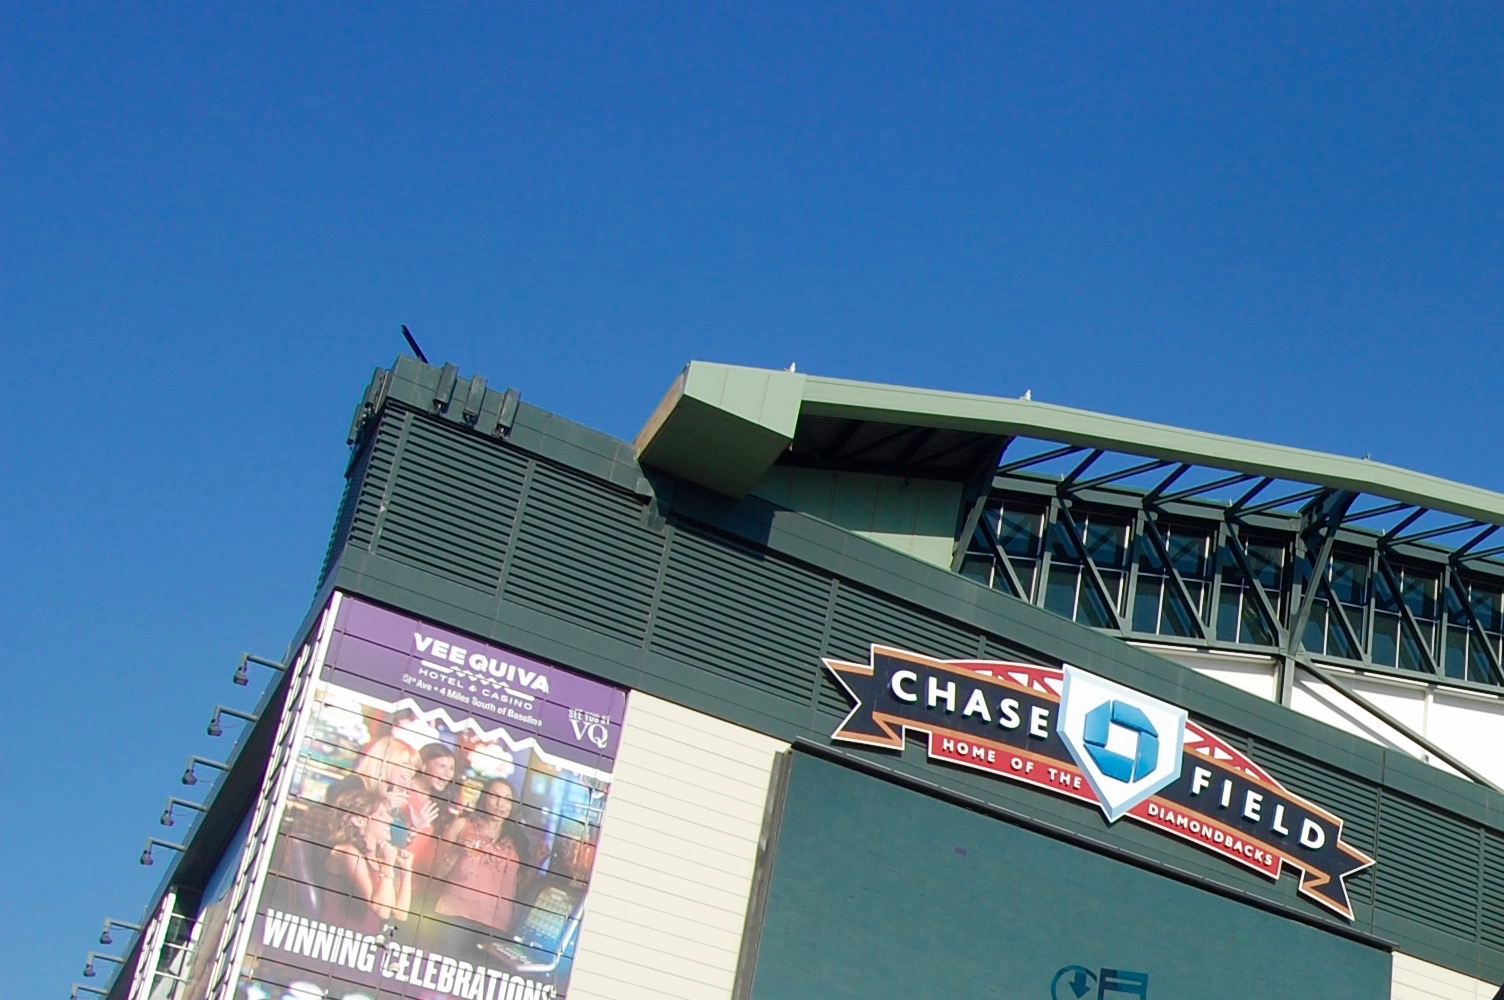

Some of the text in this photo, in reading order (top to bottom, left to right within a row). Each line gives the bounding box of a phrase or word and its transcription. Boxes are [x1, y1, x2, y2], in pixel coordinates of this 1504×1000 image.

[413, 633, 549, 694] VEE QUIVA
[419, 668, 533, 710] HOTEL & CASINO
[416, 679, 432, 691] Ave
[447, 688, 470, 704] Miles
[472, 696, 496, 713] South
[497, 706, 506, 715] of
[569, 719, 608, 749] VQ
[890, 669, 1325, 850] CHASE FIELD
[942, 738, 1274, 868] HOME OF THE DIAMONDBACKS
[262, 909, 378, 972] WINNING
